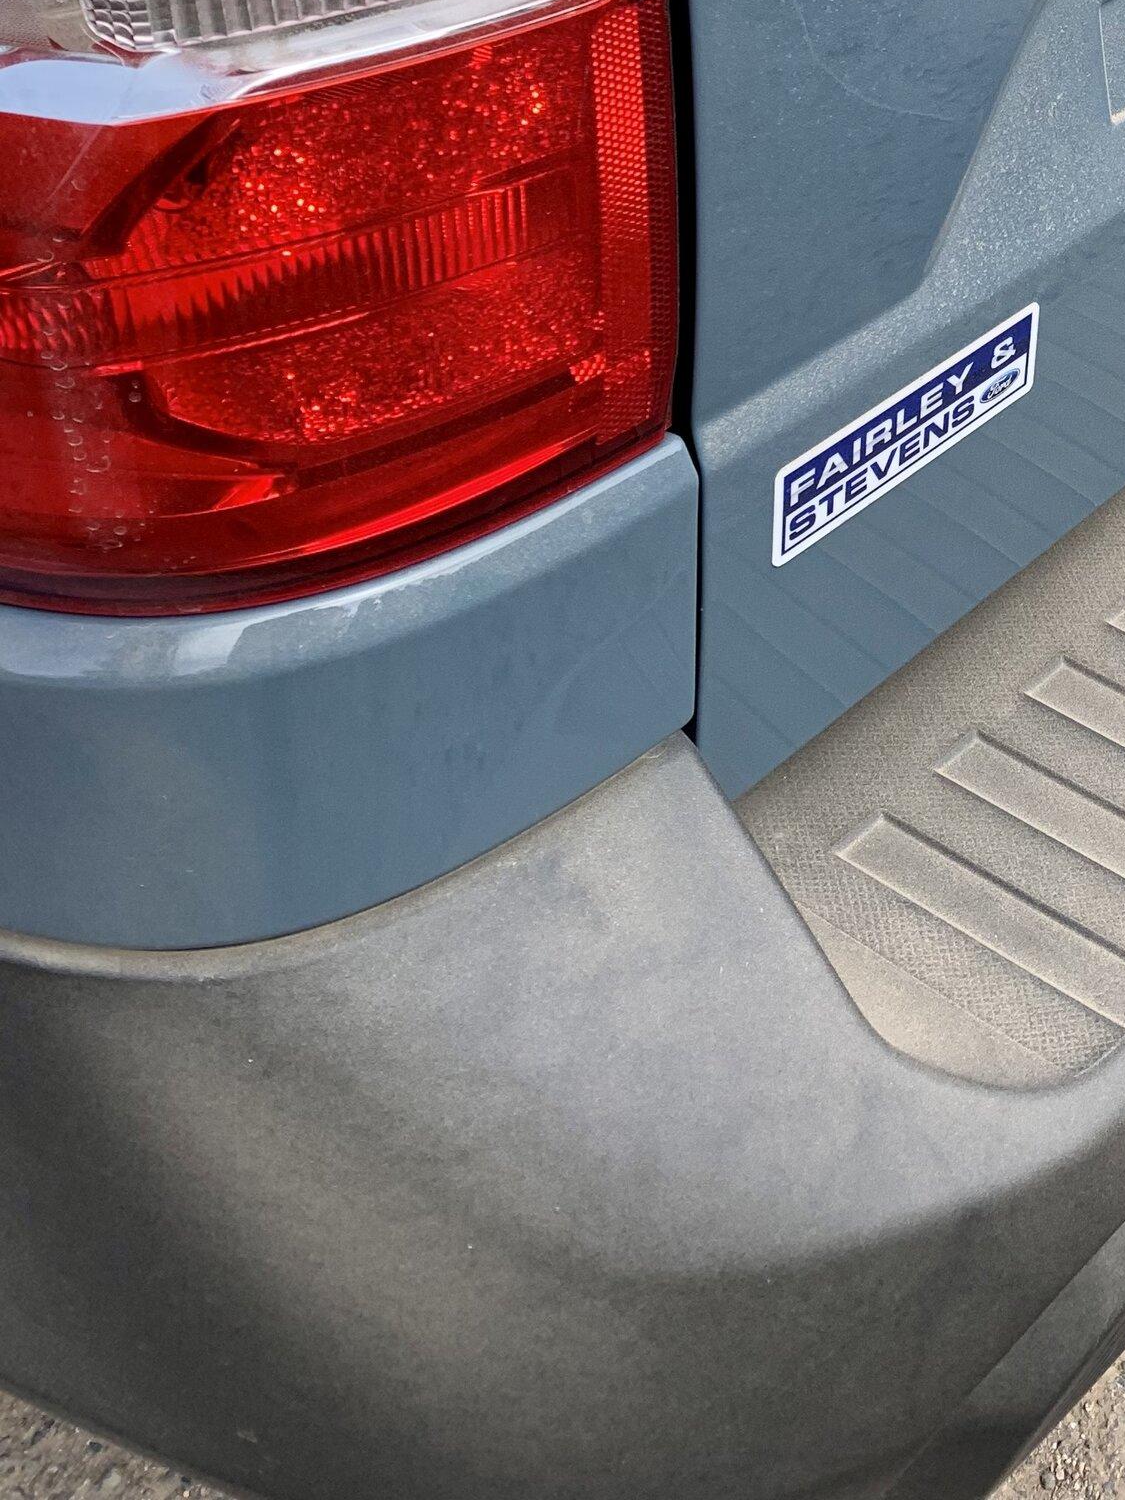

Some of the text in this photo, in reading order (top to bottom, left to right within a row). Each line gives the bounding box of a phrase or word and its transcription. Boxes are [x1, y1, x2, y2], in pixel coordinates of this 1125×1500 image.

[788, 395, 976, 541] STEVENS
[789, 336, 1017, 507] FAIRLEY &
